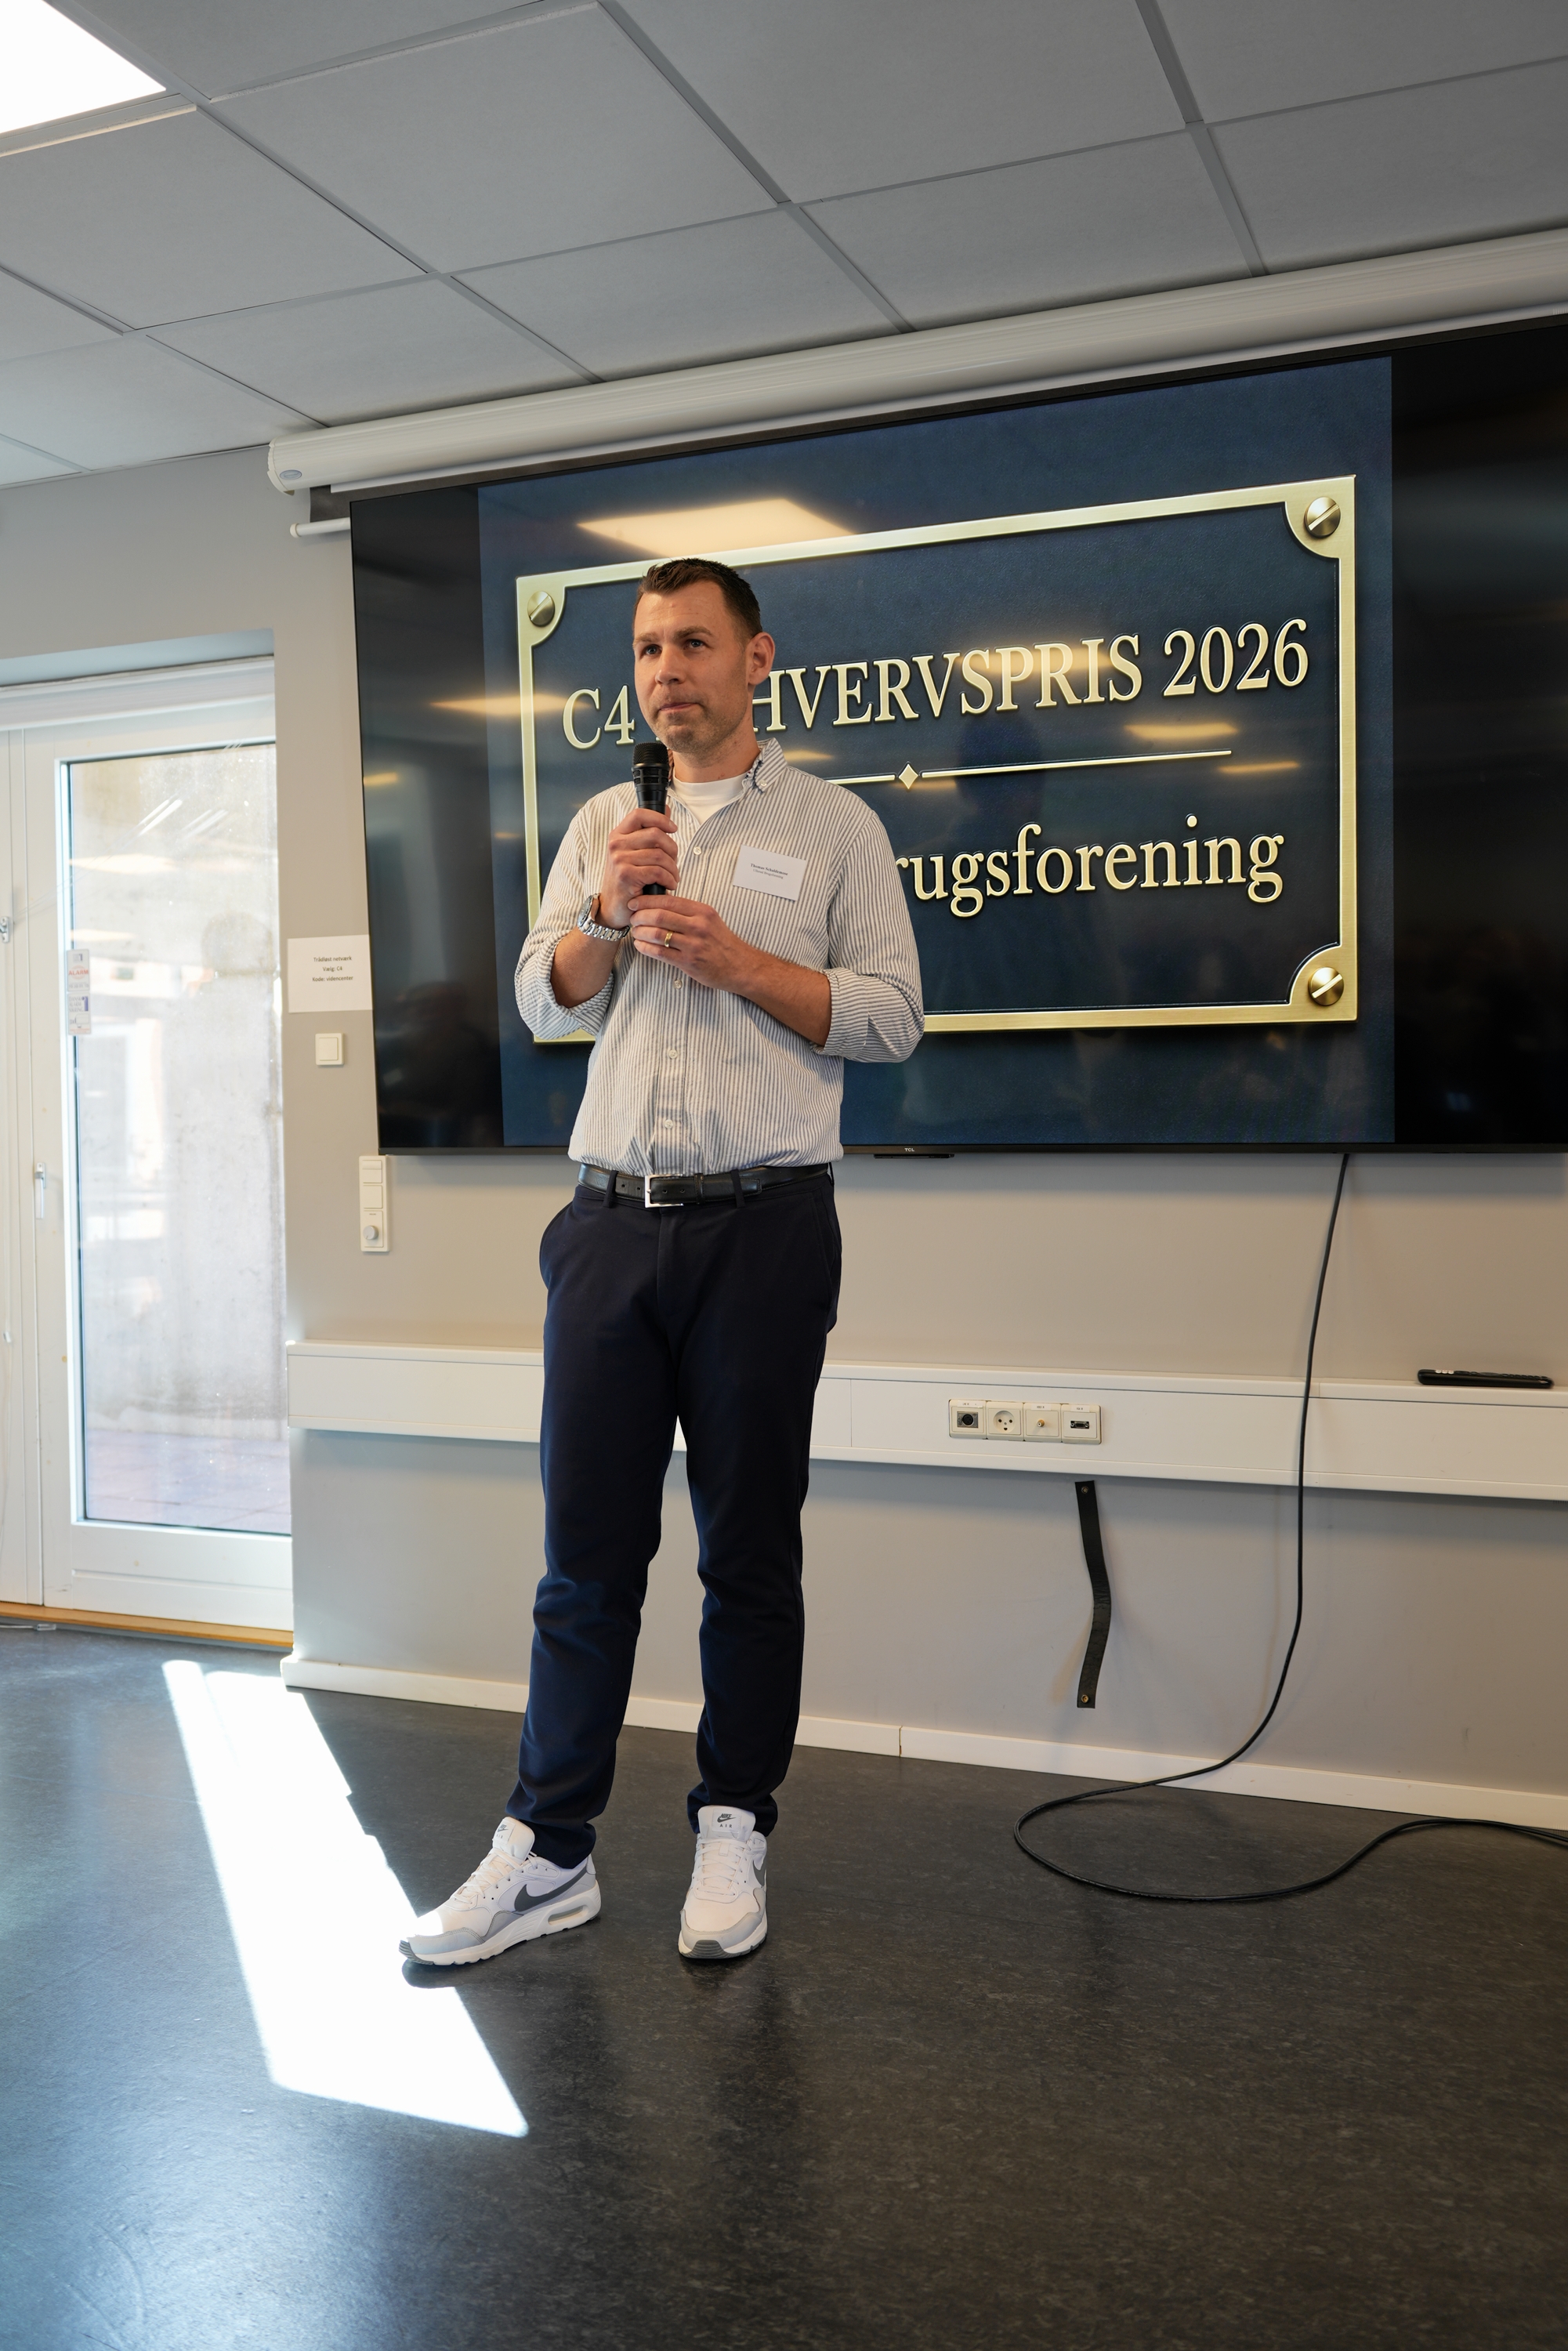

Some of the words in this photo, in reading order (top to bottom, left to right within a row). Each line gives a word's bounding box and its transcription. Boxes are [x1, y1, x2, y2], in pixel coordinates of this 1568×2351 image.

[563, 685, 635, 750] C4
[752, 634, 1143, 733] HVERVSPRIS
[1164, 618, 1309, 697] 2026
[895, 813, 1284, 917] ugsforening
